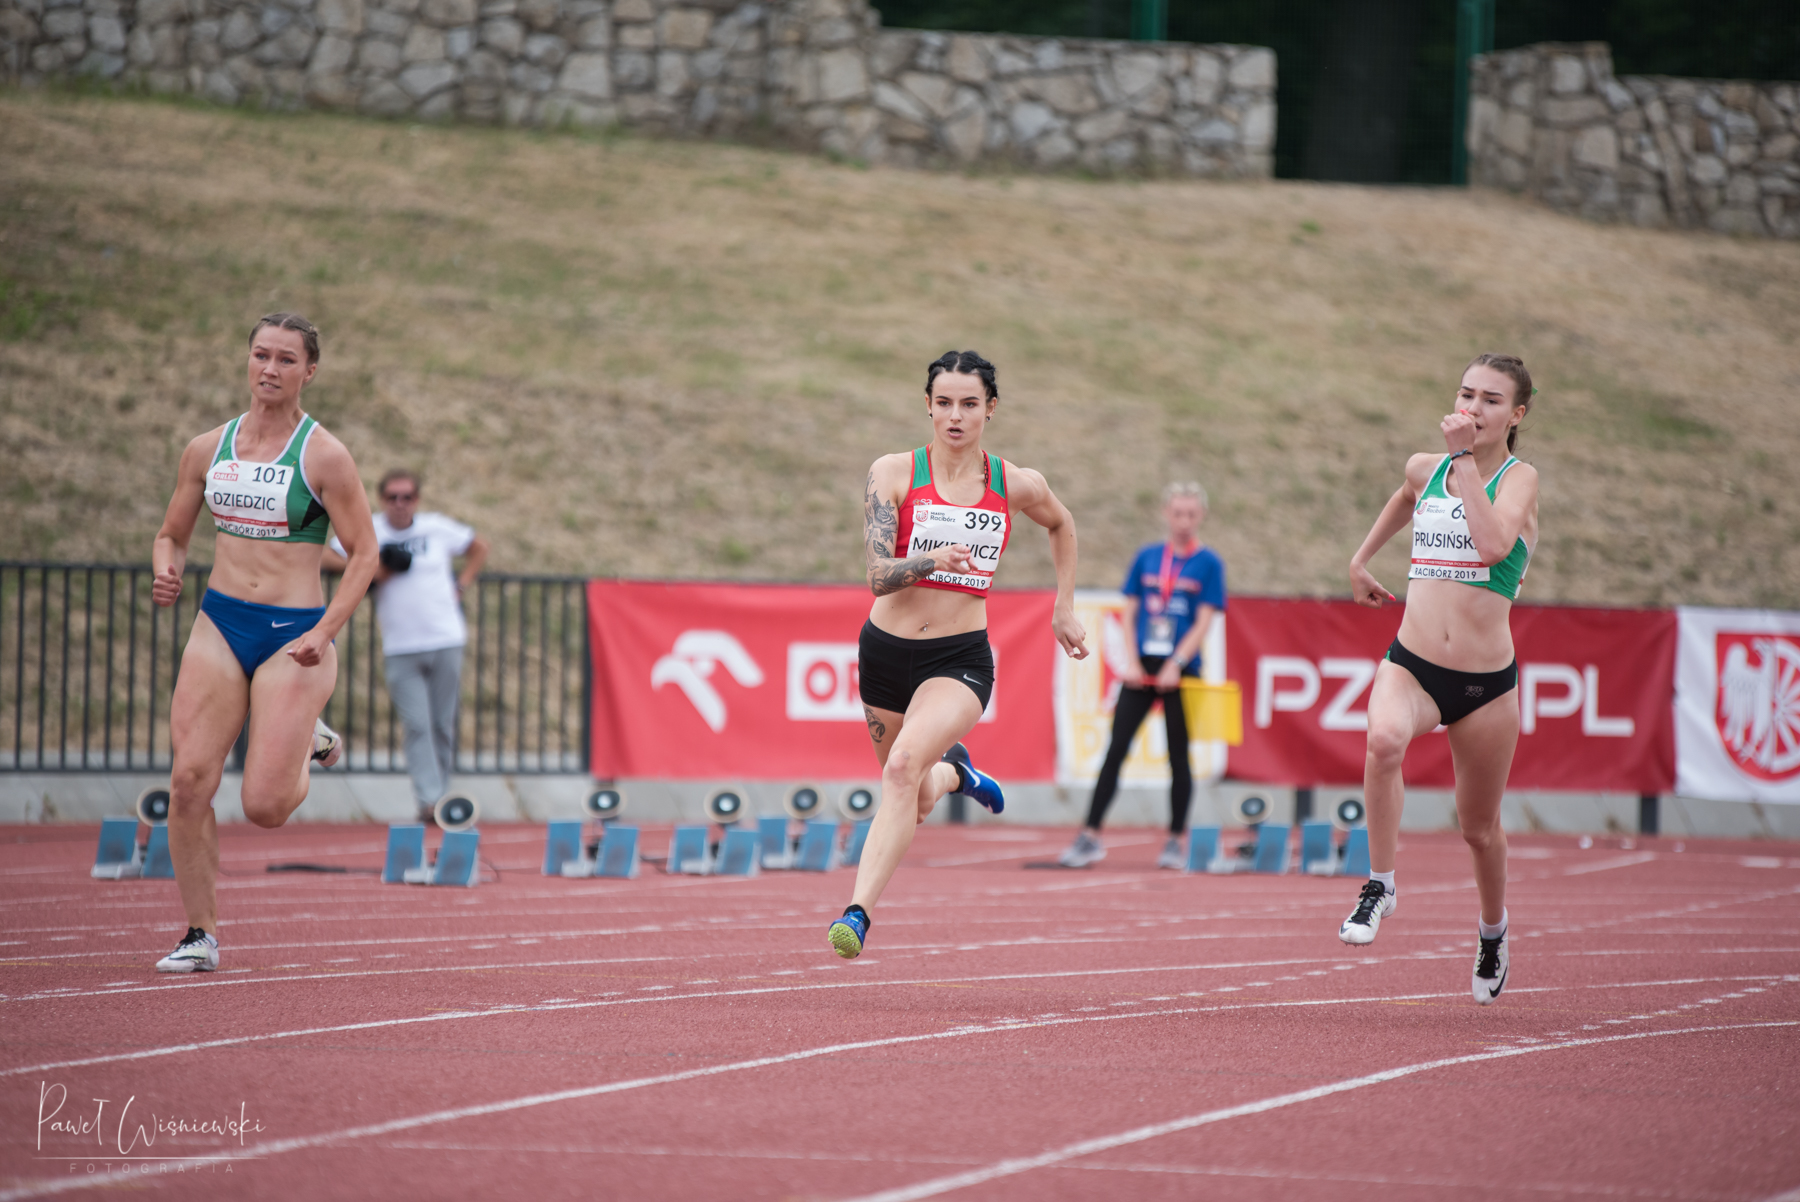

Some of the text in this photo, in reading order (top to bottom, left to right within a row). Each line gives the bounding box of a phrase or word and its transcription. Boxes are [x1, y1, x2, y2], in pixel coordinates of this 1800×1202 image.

[214, 473, 238, 481] ORLEN
[252, 466, 287, 485] 101
[213, 492, 276, 511] DZIEDZIC
[964, 511, 1002, 532] 399
[256, 528, 277, 537] 2019
[1414, 531, 1477, 550] PRUSIŃSK
[1454, 570, 1477, 579] 2019
[965, 577, 986, 588] 2019
